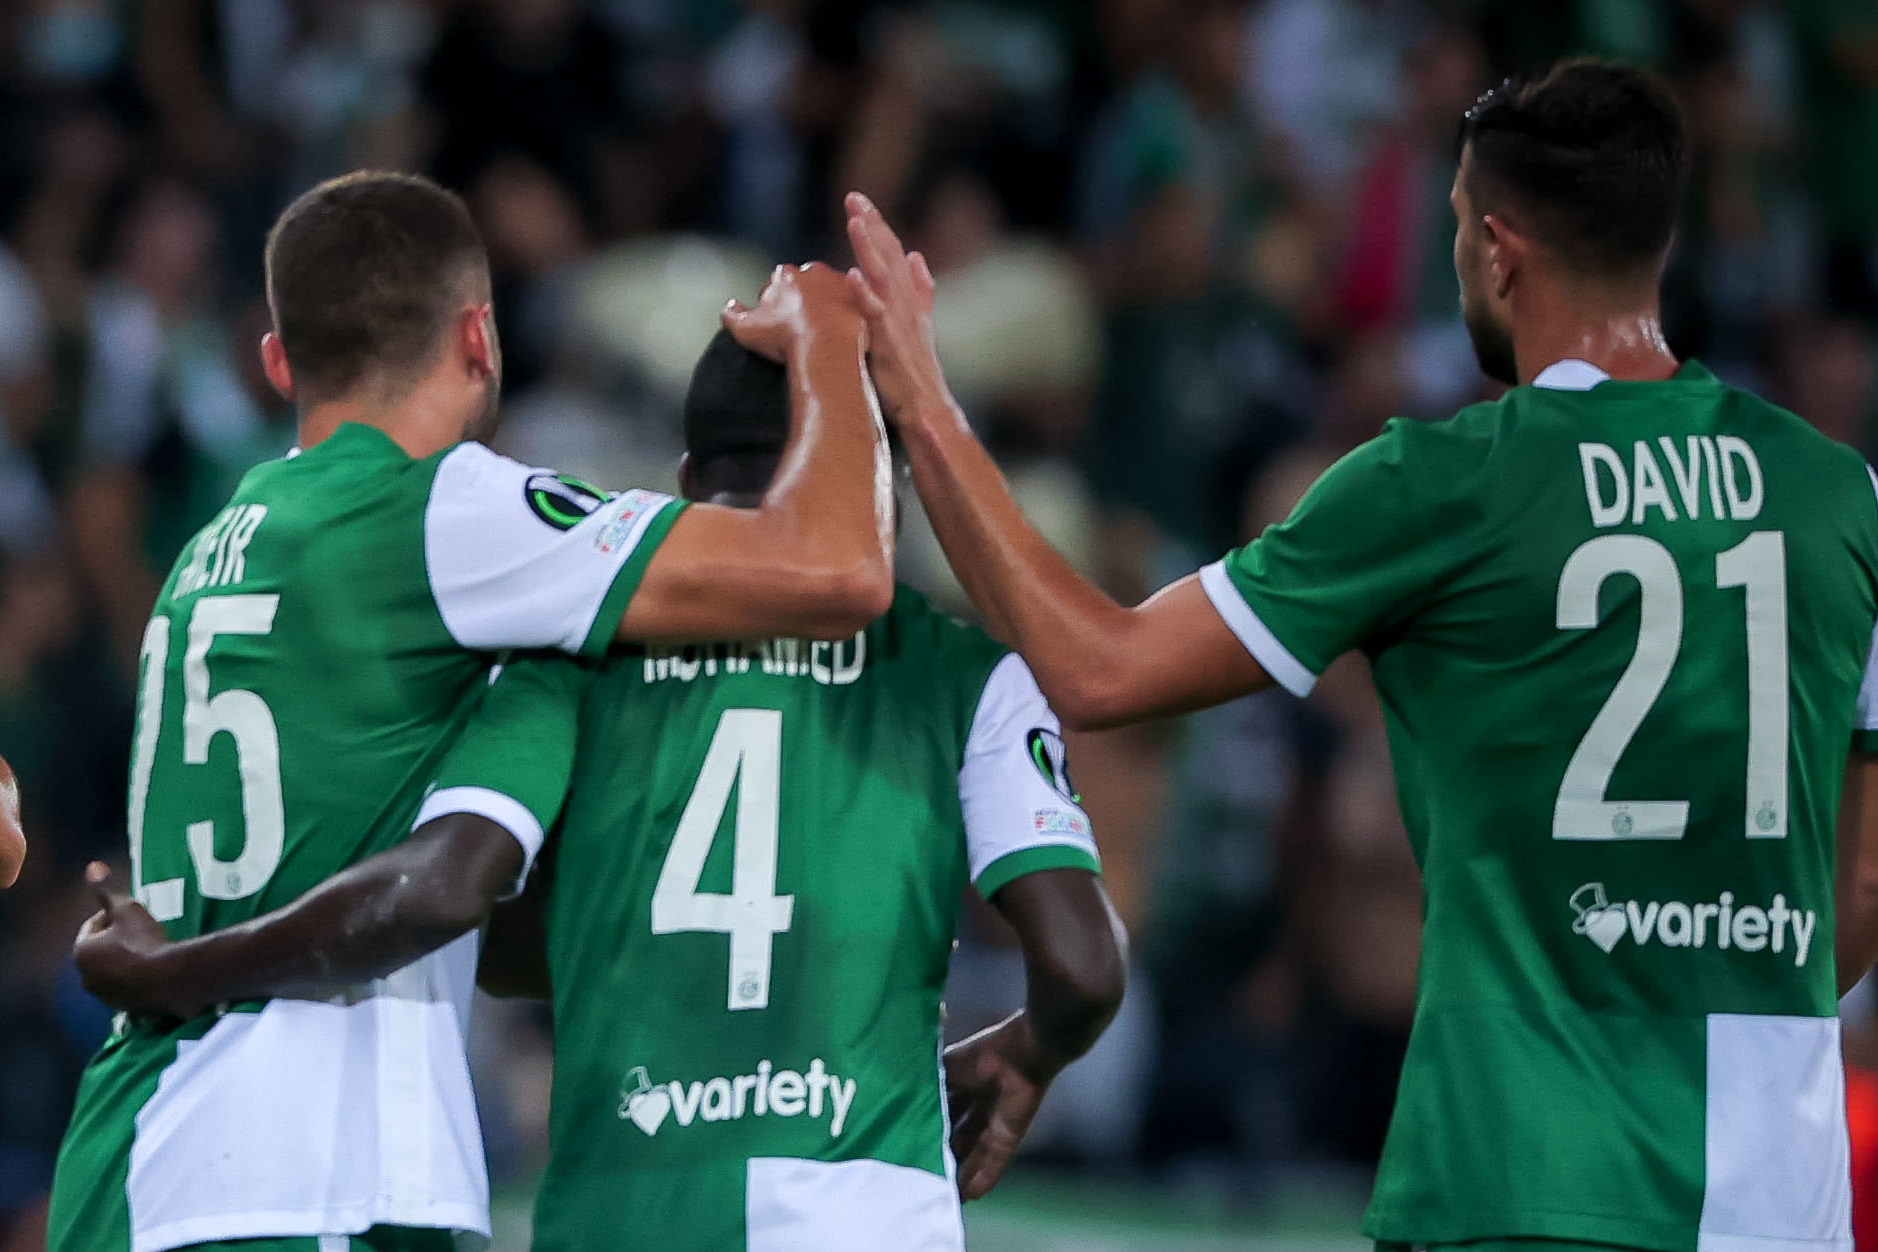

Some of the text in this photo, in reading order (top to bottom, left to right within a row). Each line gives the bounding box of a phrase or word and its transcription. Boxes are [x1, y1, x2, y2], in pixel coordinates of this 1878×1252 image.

[1577, 434, 1765, 528] DAVID
[127, 593, 285, 923] 25
[1551, 530, 1790, 841] 21
[650, 707, 797, 1012] 4
[1626, 890, 1817, 968] variety
[668, 1057, 858, 1138] variety
